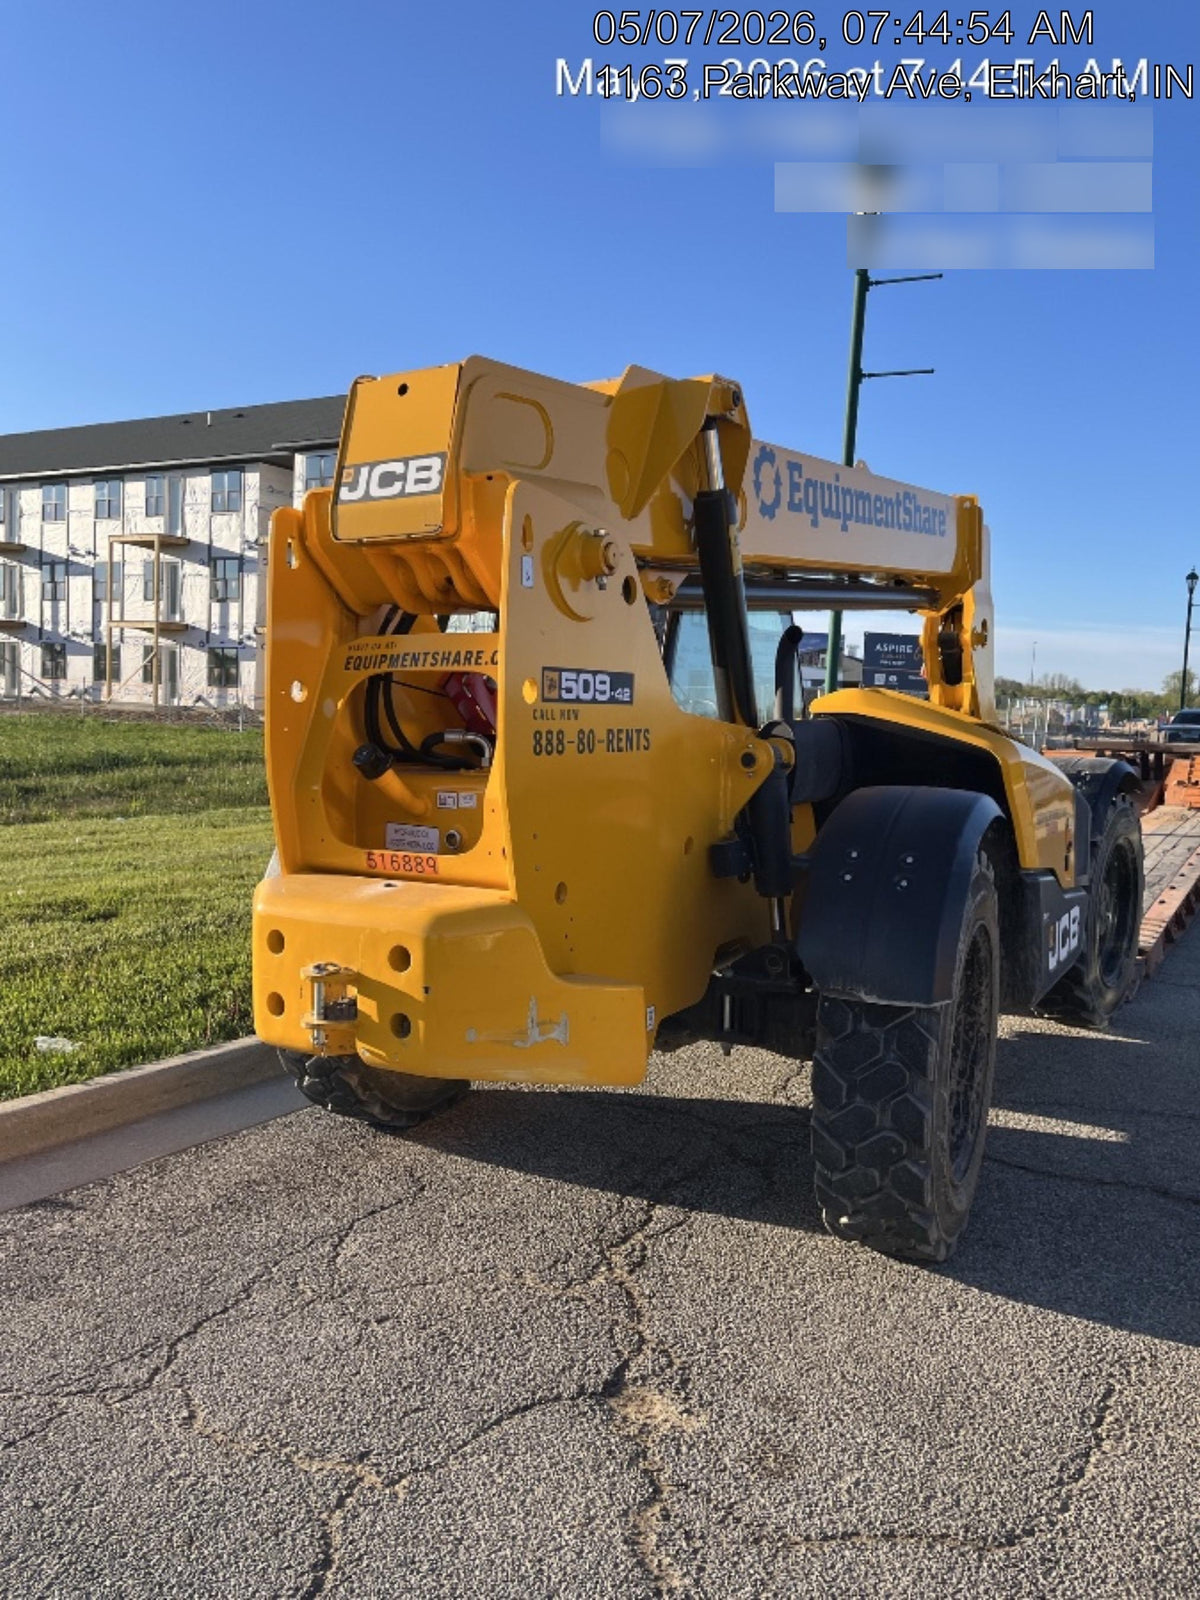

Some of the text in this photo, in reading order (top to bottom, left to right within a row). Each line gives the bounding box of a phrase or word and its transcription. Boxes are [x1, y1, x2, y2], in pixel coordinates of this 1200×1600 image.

[340, 456, 442, 500] JCB
[787, 460, 947, 537] EquipmentShare
[875, 643, 913, 653] ASPIRE
[533, 709, 556, 720] CALL
[533, 728, 651, 756] 888-80-RENTS
[367, 851, 438, 874] 516889
[1048, 905, 1080, 970] JCB
